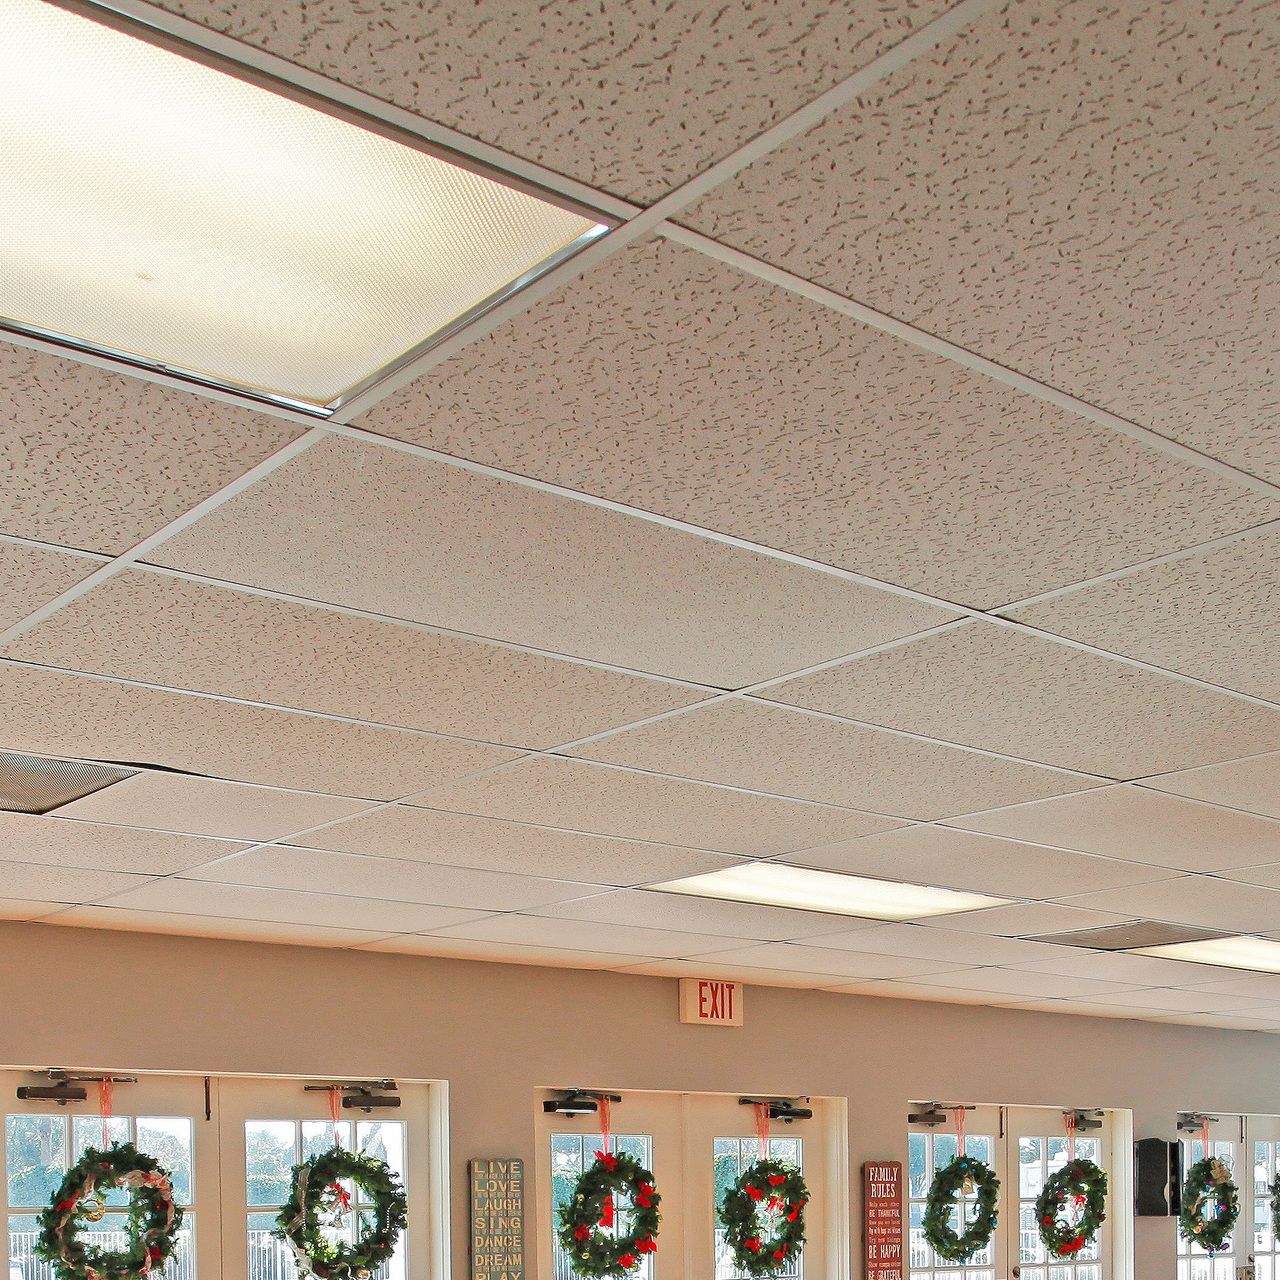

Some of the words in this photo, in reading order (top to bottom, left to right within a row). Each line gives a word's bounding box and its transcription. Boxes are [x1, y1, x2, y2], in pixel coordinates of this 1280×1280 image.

[698, 981, 735, 1020] EXIT
[474, 1161, 521, 1174] LIVE
[869, 1167, 898, 1182] FAMILY
[474, 1180, 521, 1192] LOVE
[871, 1183, 896, 1198] RULES
[474, 1198, 522, 1211] LAUGH
[869, 1209, 875, 1218] BE
[475, 1216, 521, 1229] SING
[475, 1235, 522, 1248] DANCE
[868, 1245, 877, 1259] BE
[880, 1244, 901, 1259] HAPPY
[475, 1253, 522, 1267] DREAM
[878, 1269, 902, 1280] GRATEFUL
